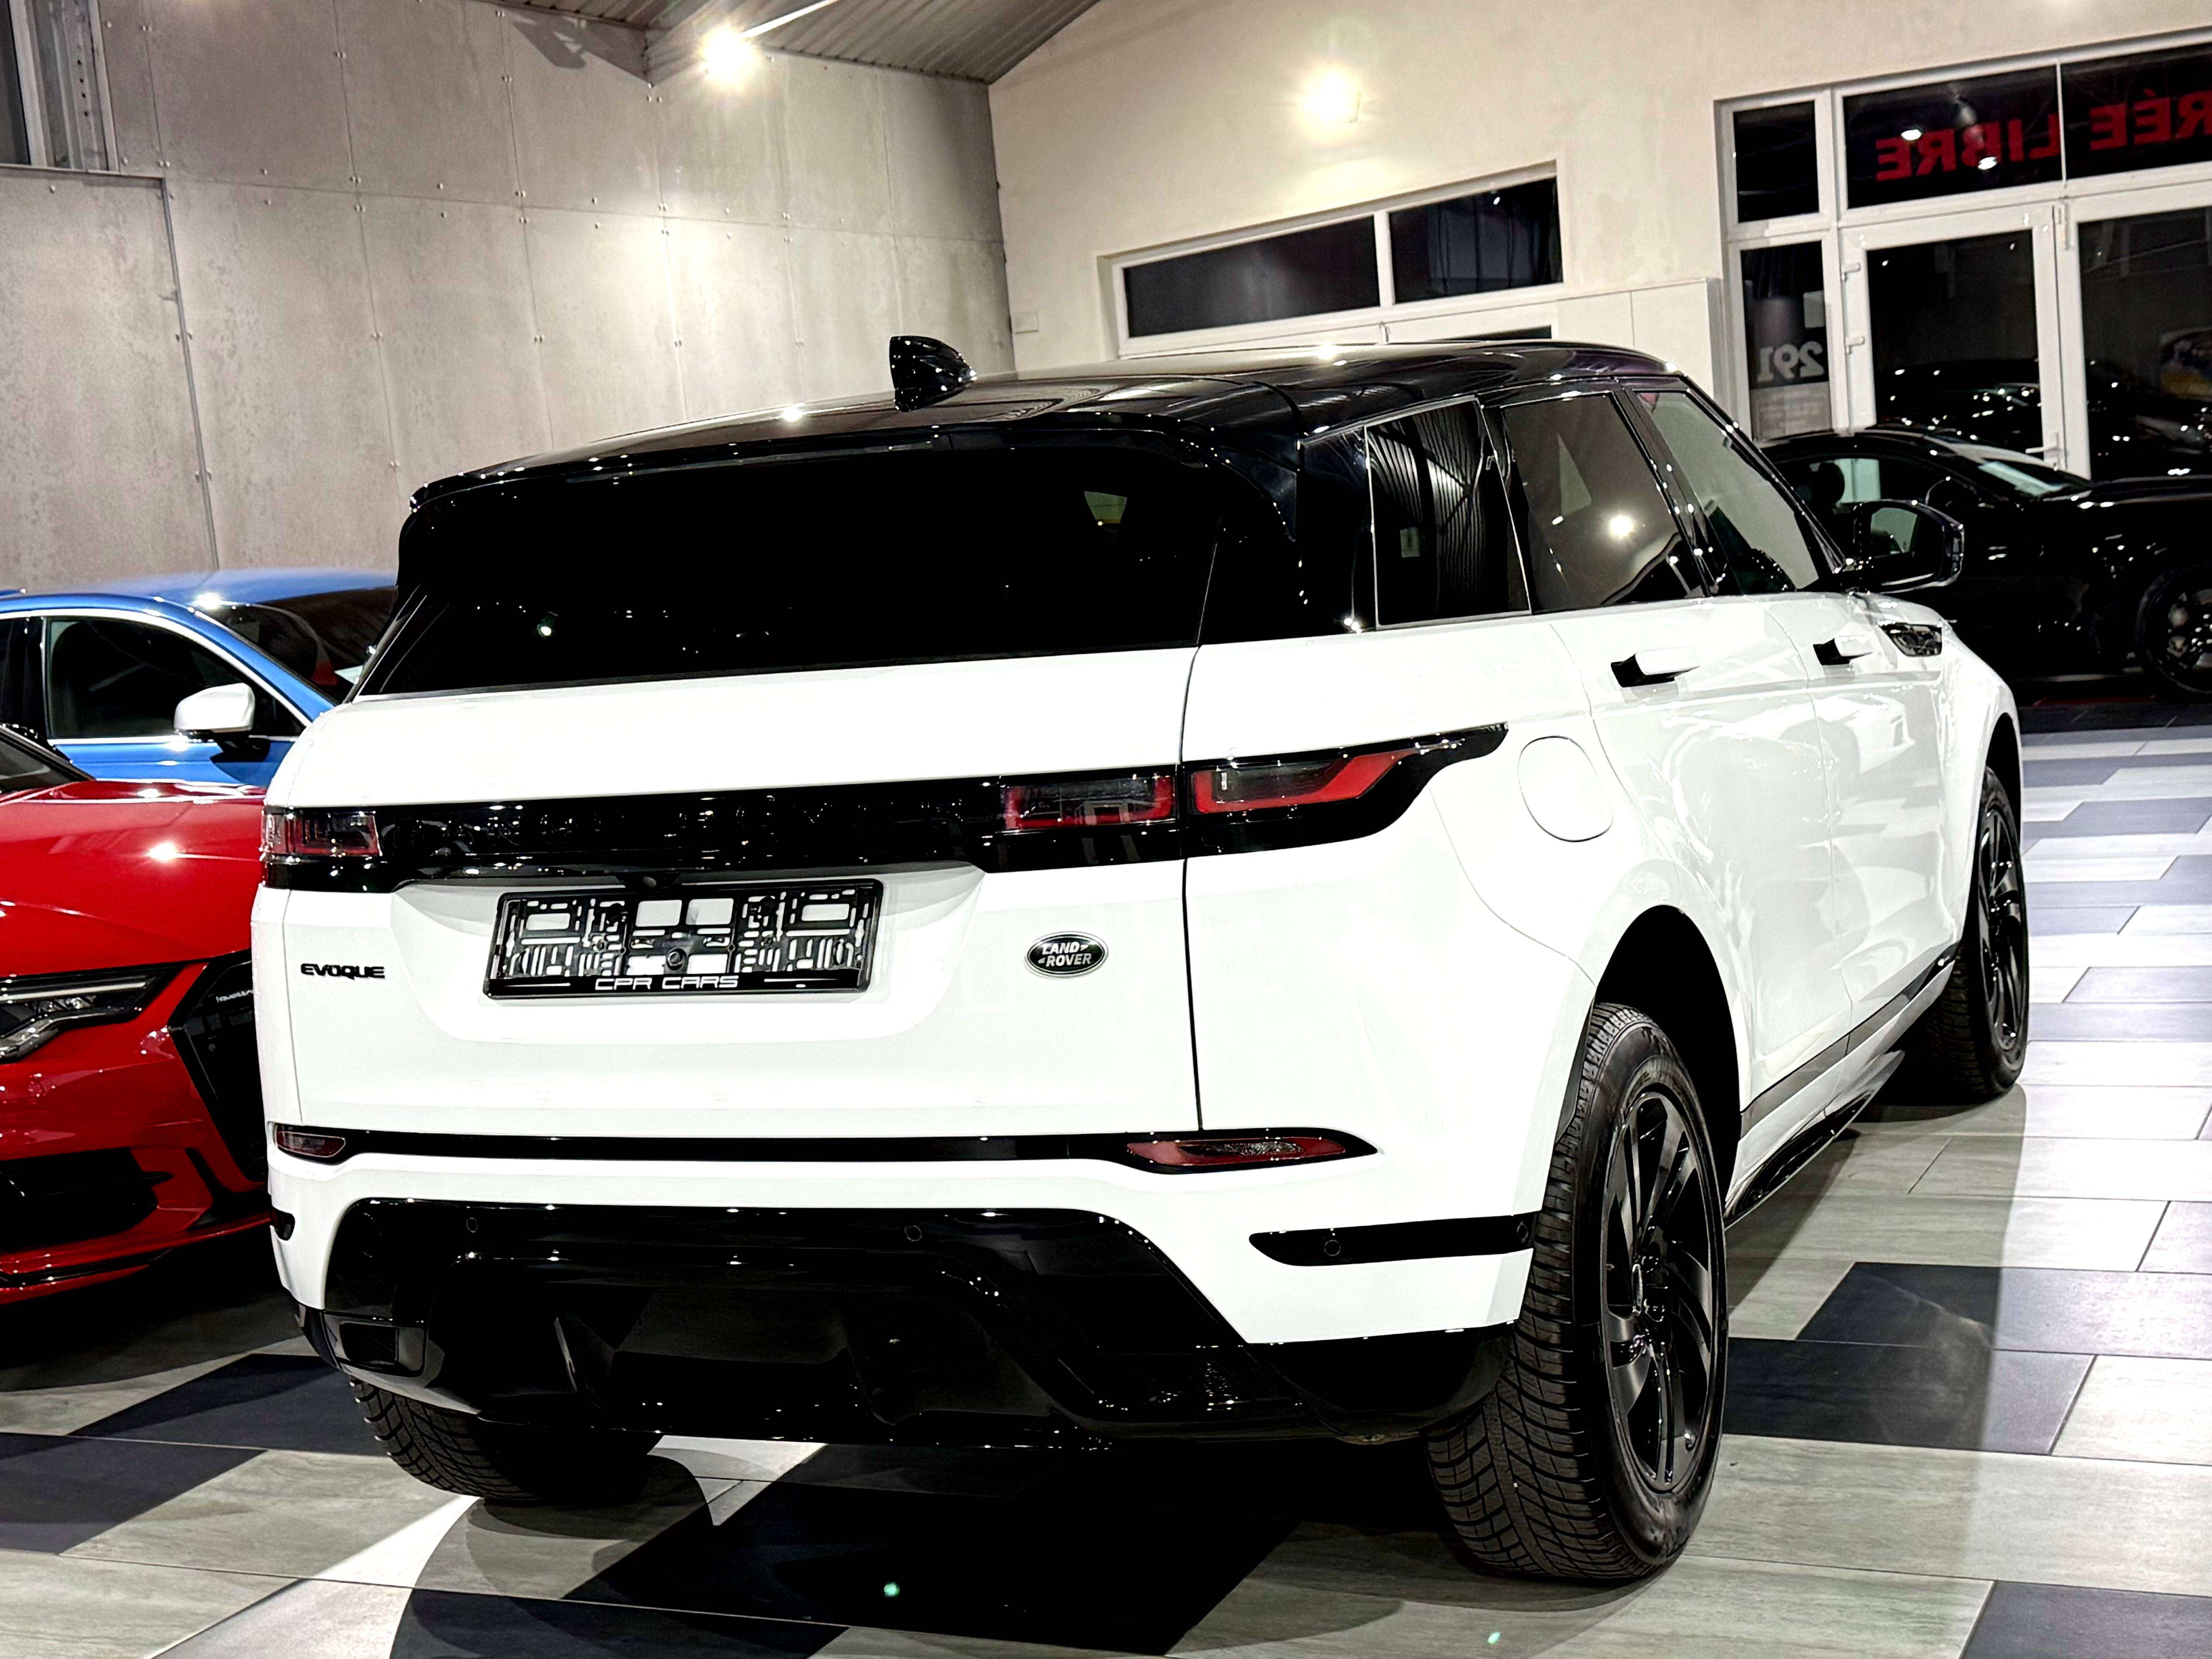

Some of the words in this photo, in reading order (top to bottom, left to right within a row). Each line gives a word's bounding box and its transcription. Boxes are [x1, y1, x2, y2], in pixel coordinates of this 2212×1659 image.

[1042, 941, 1080, 955] LAND
[1046, 953, 1092, 967] ROVER
[301, 963, 385, 979] EVOQUE
[595, 977, 653, 990] CPR
[662, 975, 739, 989] CARS
